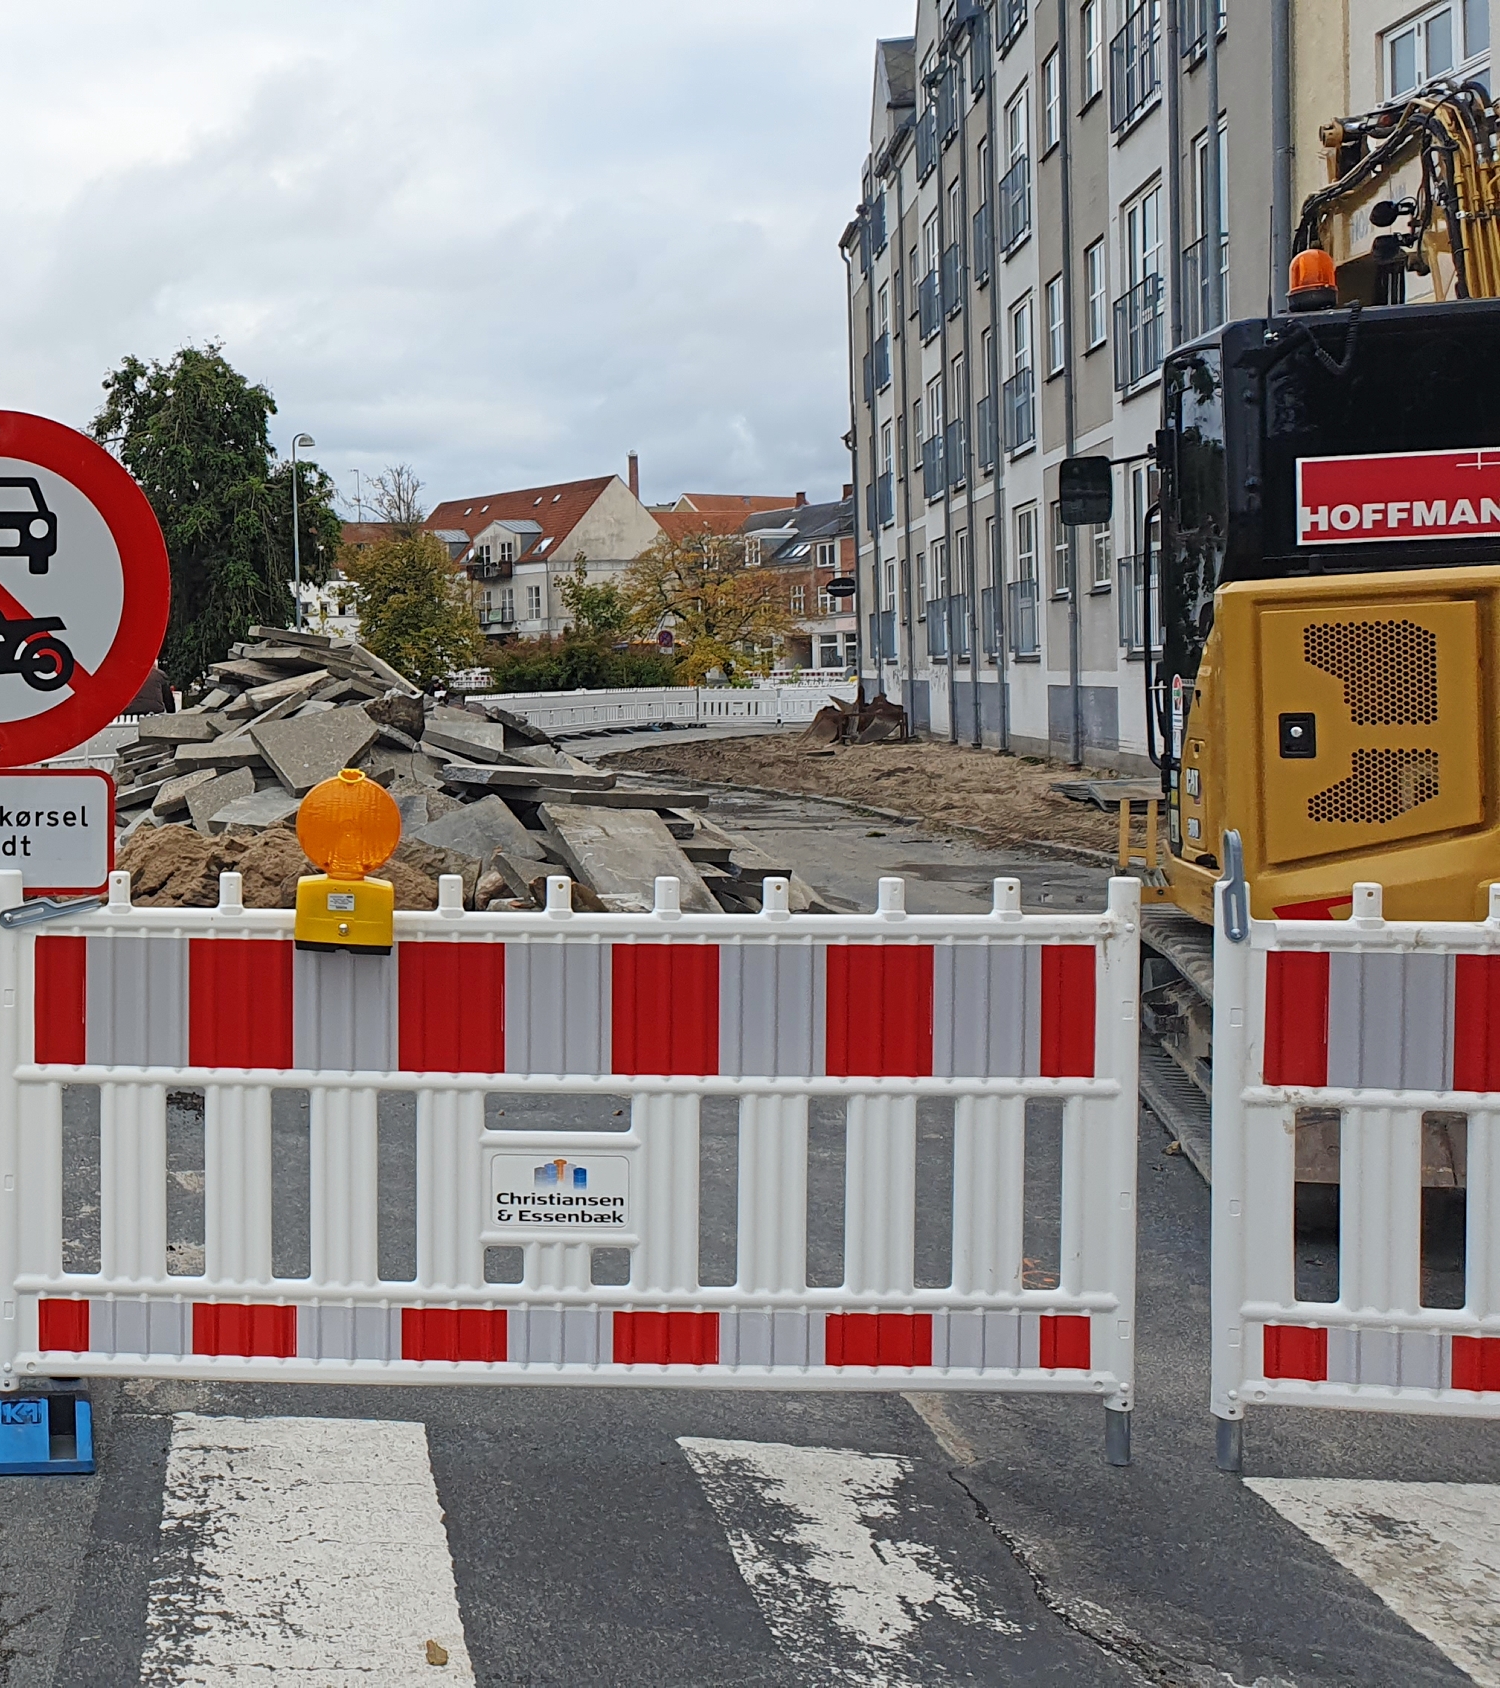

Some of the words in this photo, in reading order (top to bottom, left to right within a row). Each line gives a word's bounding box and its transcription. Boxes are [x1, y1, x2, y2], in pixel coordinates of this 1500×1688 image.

[496, 1192, 624, 1207] Christiansen
[497, 1209, 513, 1222] &
[518, 1210, 624, 1223] Essenbæk
